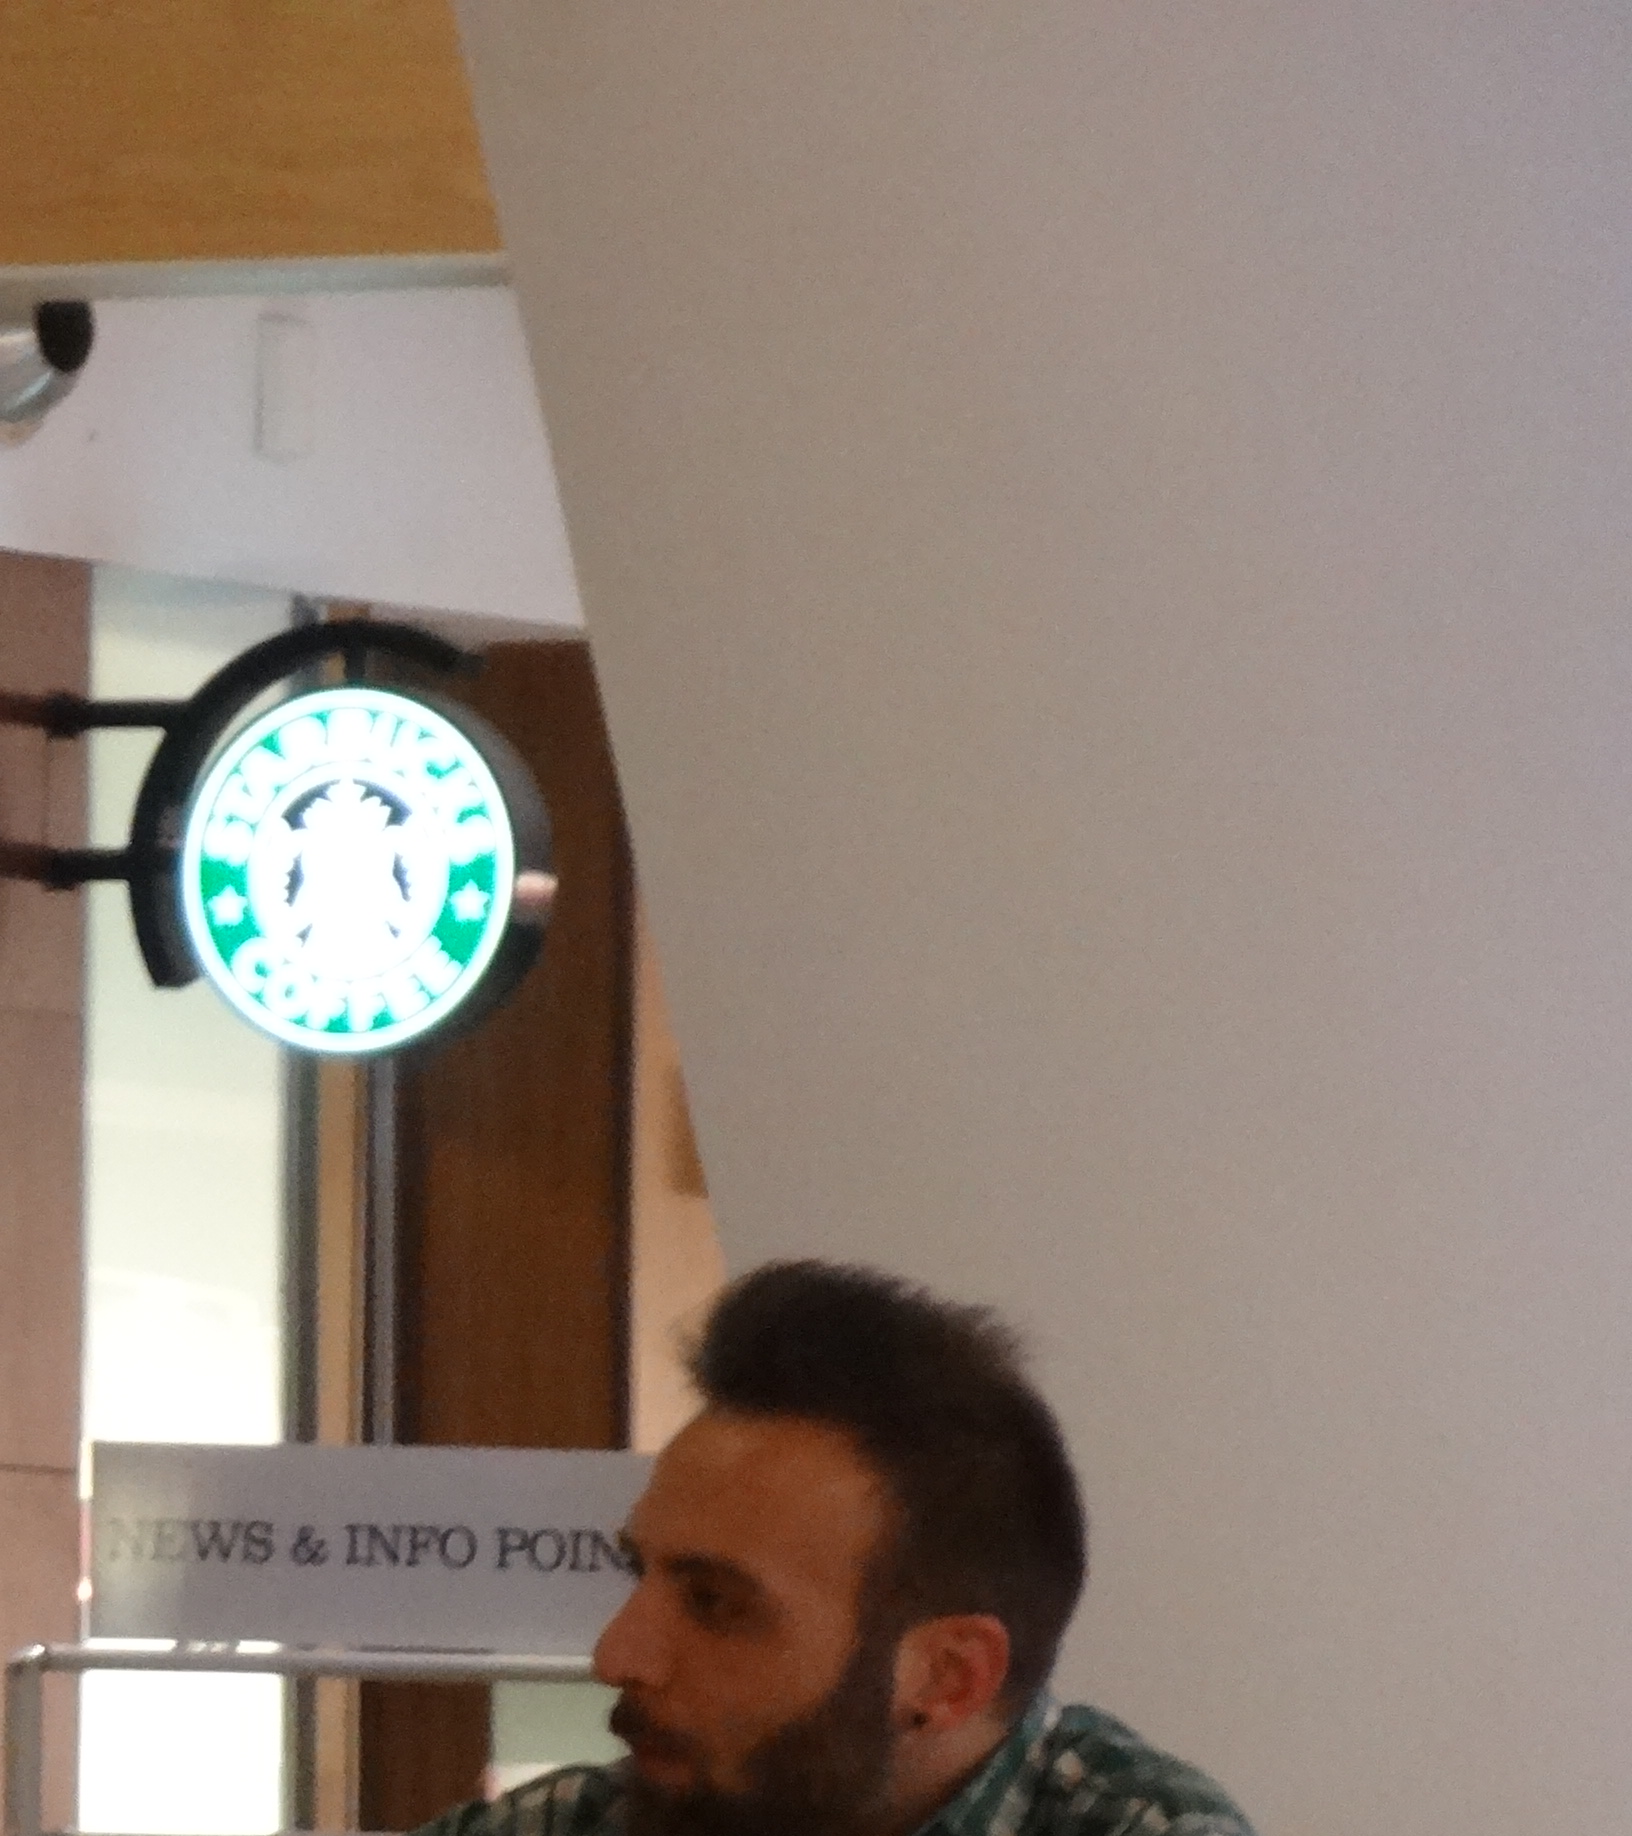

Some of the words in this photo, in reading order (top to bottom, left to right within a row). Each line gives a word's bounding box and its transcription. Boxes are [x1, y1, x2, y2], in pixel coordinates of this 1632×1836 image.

[108, 1520, 277, 1566] NEWS
[291, 1525, 327, 1568] &
[344, 1523, 478, 1569] INFO
[494, 1526, 638, 1574] POIN
